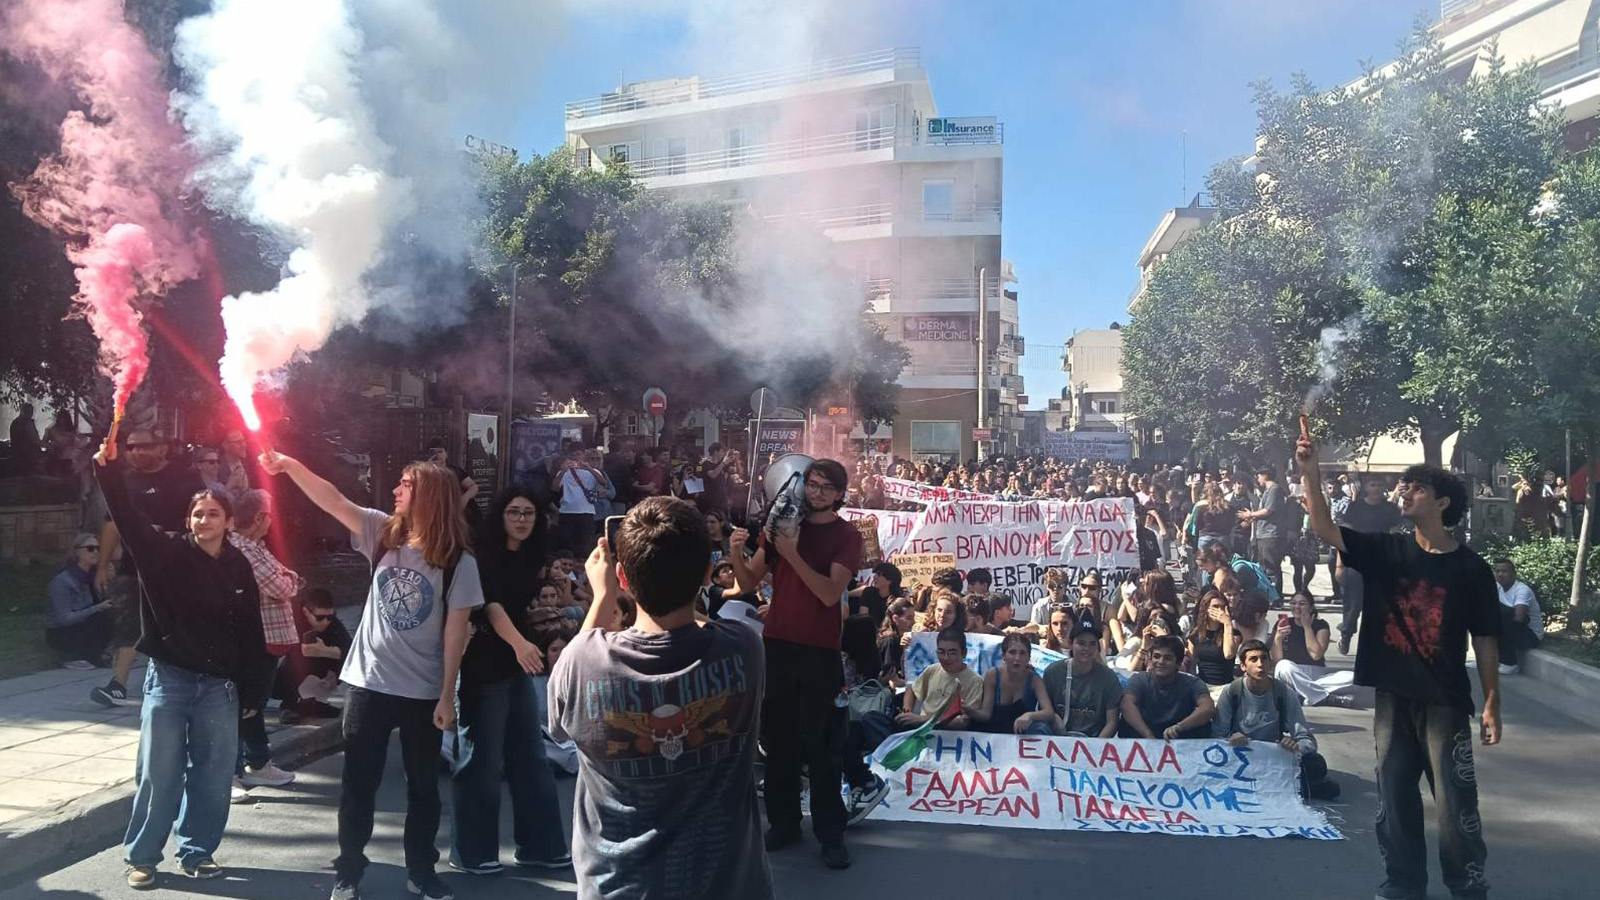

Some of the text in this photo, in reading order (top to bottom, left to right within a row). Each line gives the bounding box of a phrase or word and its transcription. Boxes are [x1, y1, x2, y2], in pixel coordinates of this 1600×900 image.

[918, 321, 957, 331] DERMA
[918, 330, 968, 340] MEDICINE
[761, 430, 798, 440] NEWS
[760, 442, 795, 452] BREAK
[962, 503, 1003, 525] ΜΕΧΡΙ
[1013, 503, 1040, 523] ΤΗΝ
[1047, 502, 1128, 525] ΕΛΛΑΔΑ
[957, 530, 1062, 560] ΒΓΑΙΝΟΥΜΕ
[1073, 528, 1136, 557] ΣΤΟΥΣ
[1019, 738, 1183, 775] ΕΛΛΑΔΑ
[906, 766, 1030, 799] ΓΑΛΛΙΑ
[1050, 765, 1262, 814] ΠΑΛΕΥΟΥΜΕ
[908, 791, 1040, 819] ΔΩΡΕΑΝ
[1053, 787, 1201, 824] ΠΑΙΔΕΙΑ
